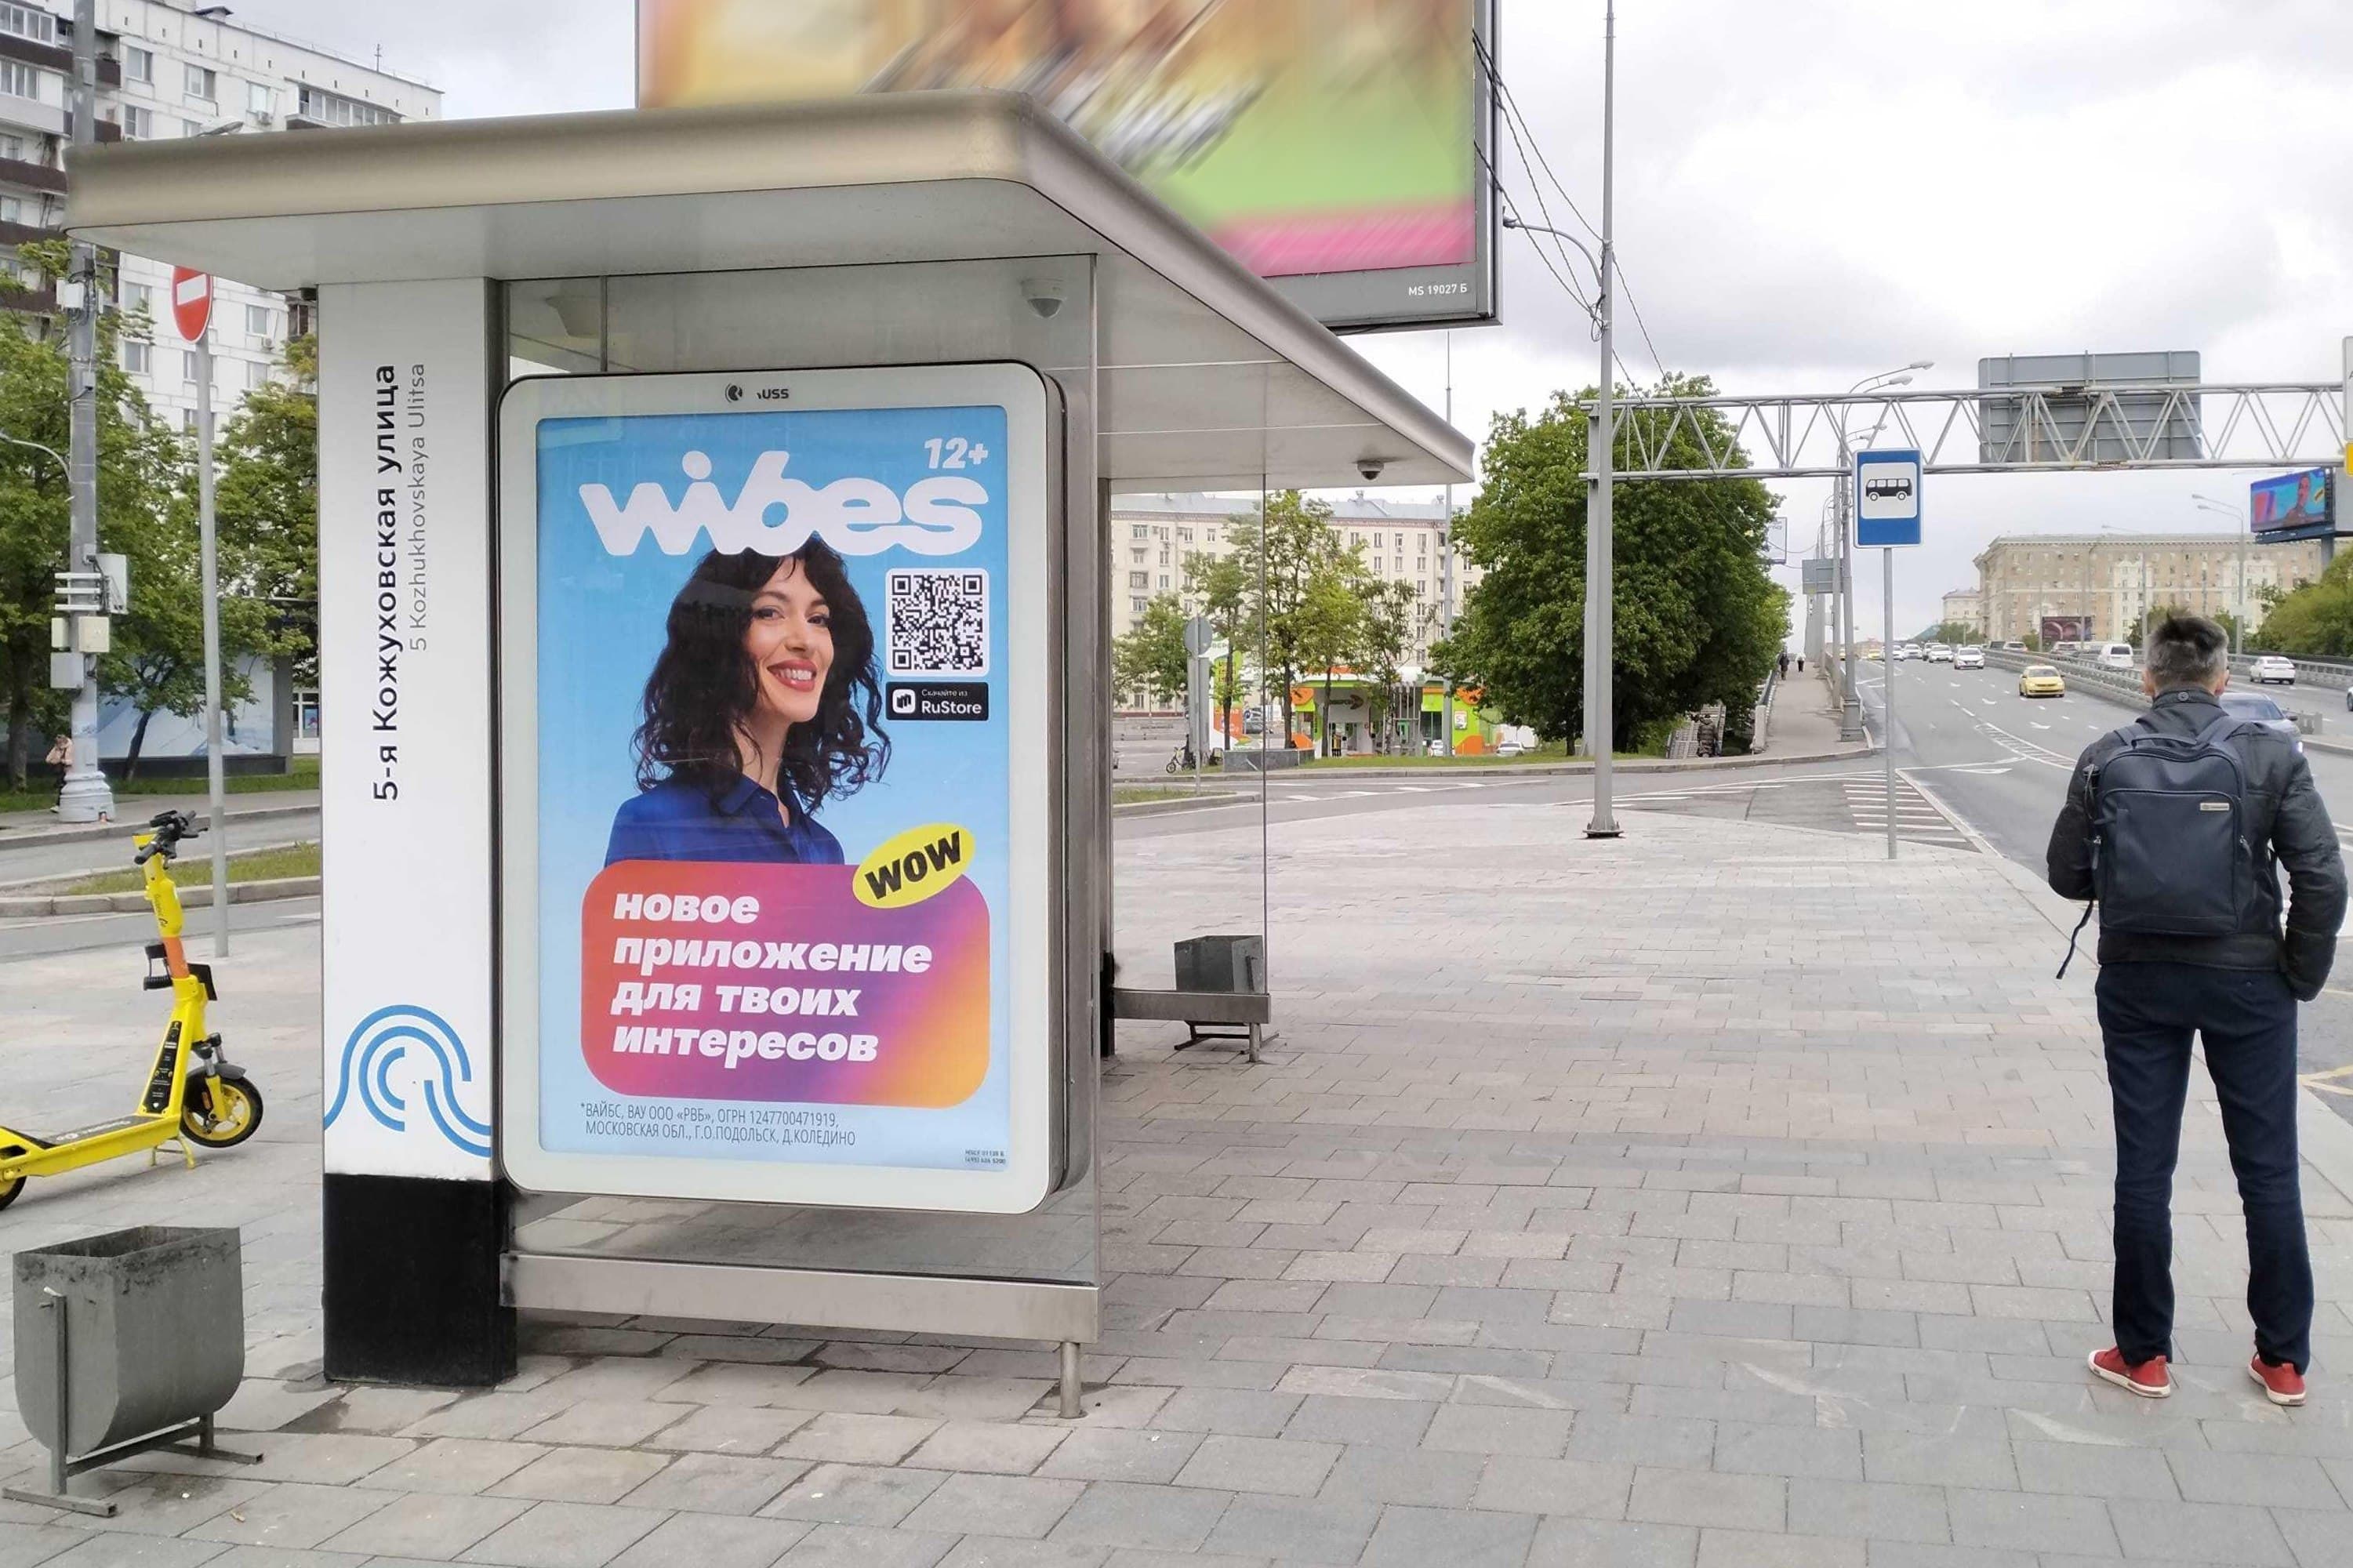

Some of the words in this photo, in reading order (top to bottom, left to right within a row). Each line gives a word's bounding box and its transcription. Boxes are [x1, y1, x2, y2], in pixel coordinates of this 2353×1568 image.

[1408, 285, 1425, 296] MS
[1428, 284, 1457, 295] 19027
[1460, 283, 1468, 293] Б
[407, 364, 425, 428] Ulitsa
[376, 365, 401, 474] улица
[925, 437, 988, 469] 12+
[579, 451, 989, 556] wibes
[408, 437, 429, 629] Kozhukhovskaya
[373, 488, 403, 731] Кожуховская
[409, 637, 427, 651] 5
[921, 700, 982, 714] RuStore
[373, 746, 398, 800] 5-я
[864, 830, 961, 900] WOW
[613, 893, 760, 924] новое
[613, 937, 932, 975] приложение
[610, 982, 702, 1015] для
[715, 985, 862, 1016] твоих
[613, 1025, 879, 1068] интересов
[586, 1120, 659, 1137] МОСКОВСКАЯ
[663, 1123, 692, 1140] ОБЛ.,
[782, 1128, 855, 1147] Д.КОЛЕДИНО
[628, 1105, 647, 1119] ВАУ
[649, 1105, 674, 1120] ООО
[677, 1107, 714, 1123] «РВБ»,
[717, 1109, 746, 1123] ОГРН
[750, 1110, 840, 1128] 1247700471919,
